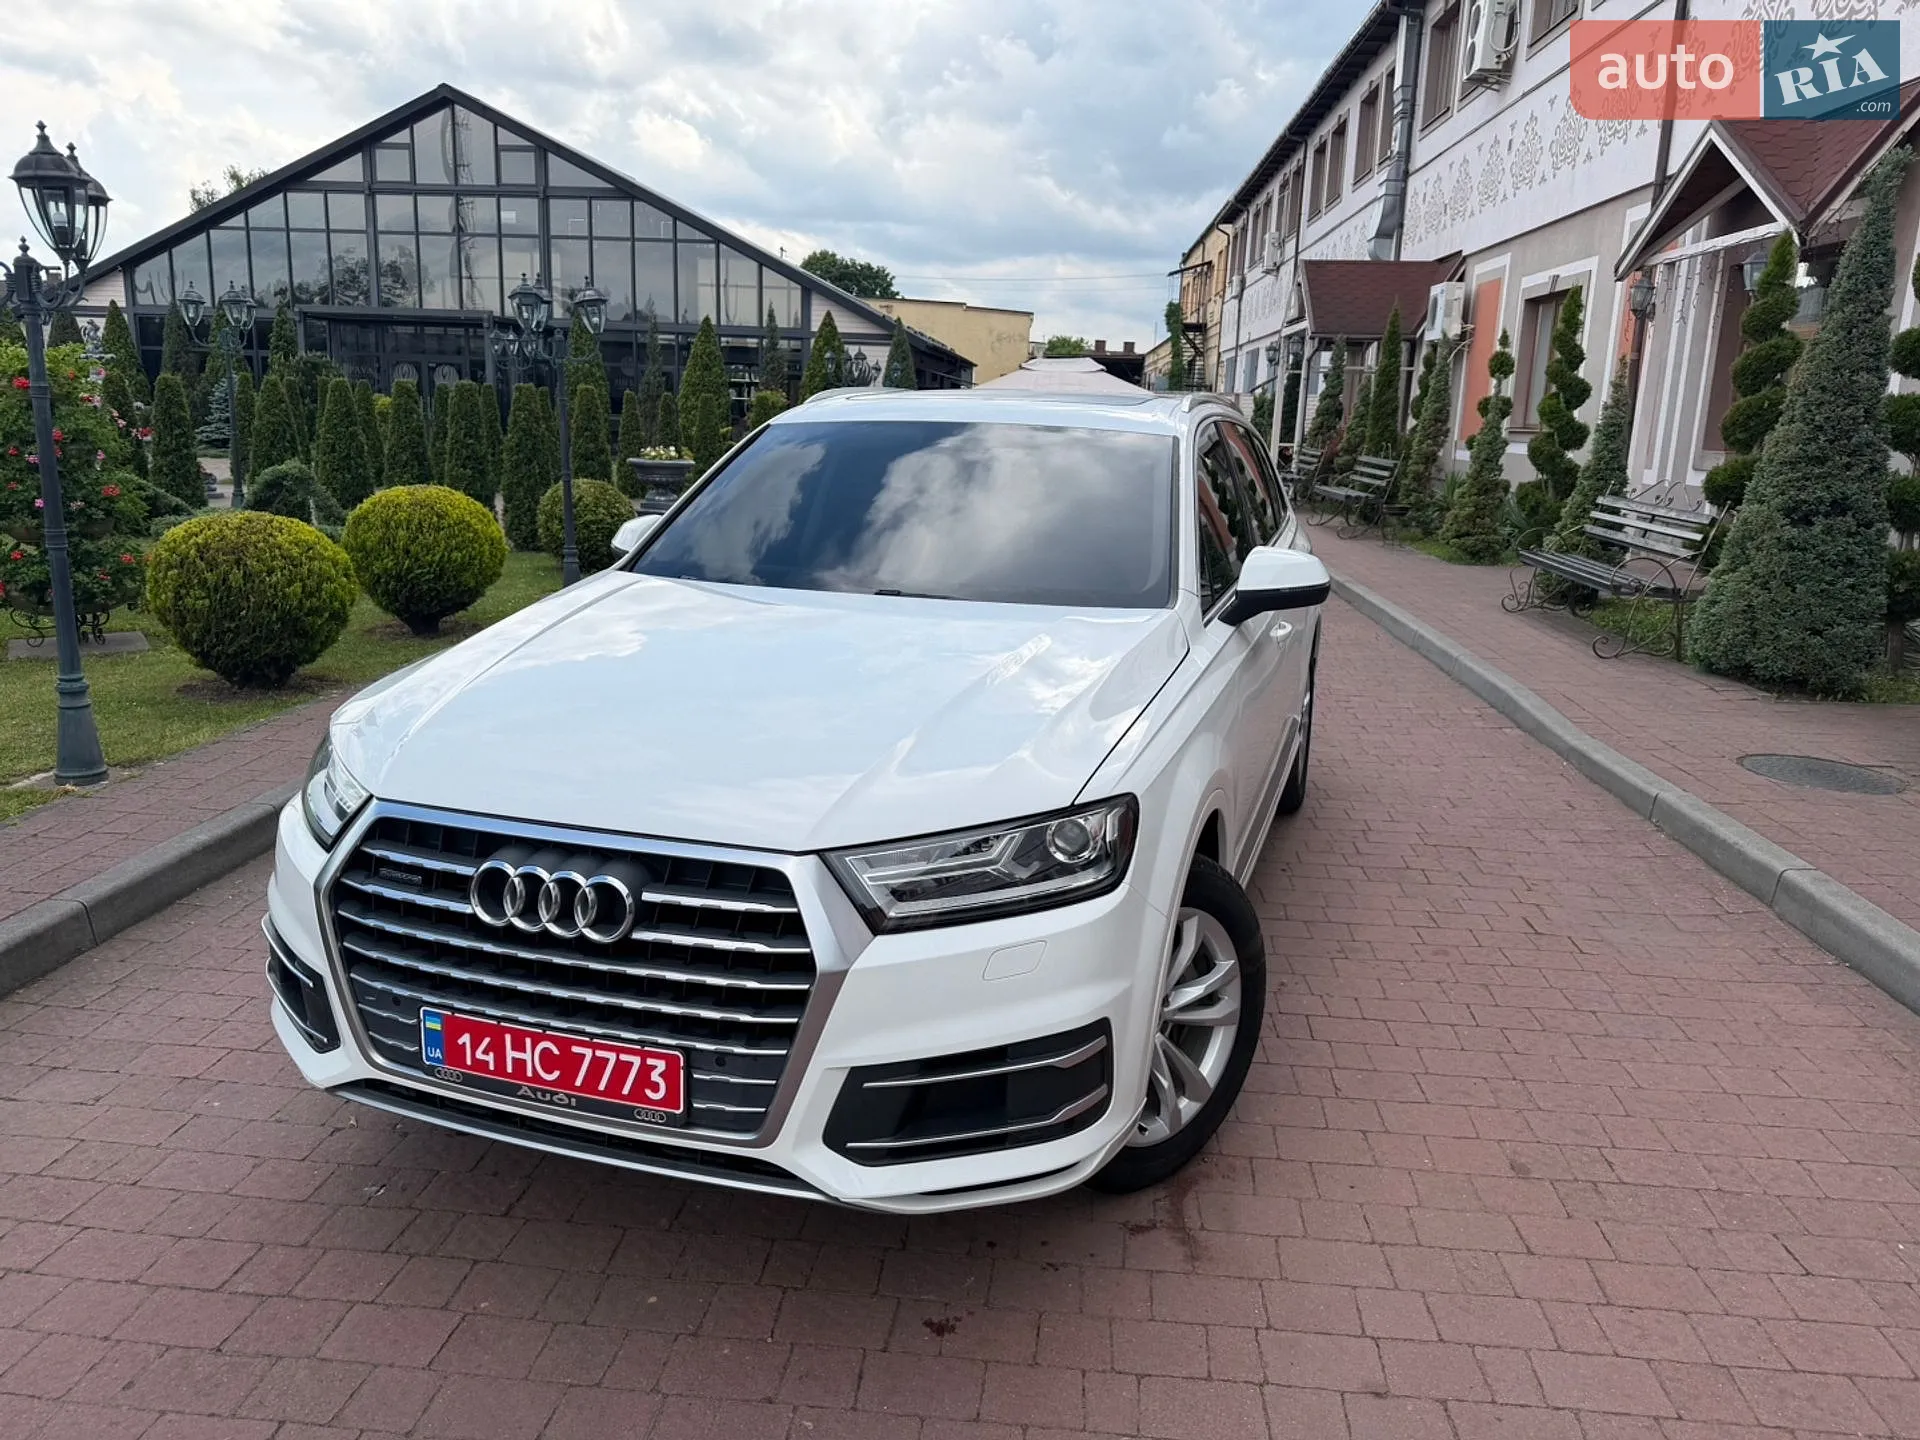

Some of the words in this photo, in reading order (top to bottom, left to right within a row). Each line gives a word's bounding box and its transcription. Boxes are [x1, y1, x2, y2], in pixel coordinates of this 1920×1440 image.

[427, 1047, 442, 1060] UA
[457, 1033, 495, 1071] 14
[505, 1033, 560, 1081] HC
[571, 1045, 667, 1100] 7773
[516, 1086, 577, 1107] Audi
